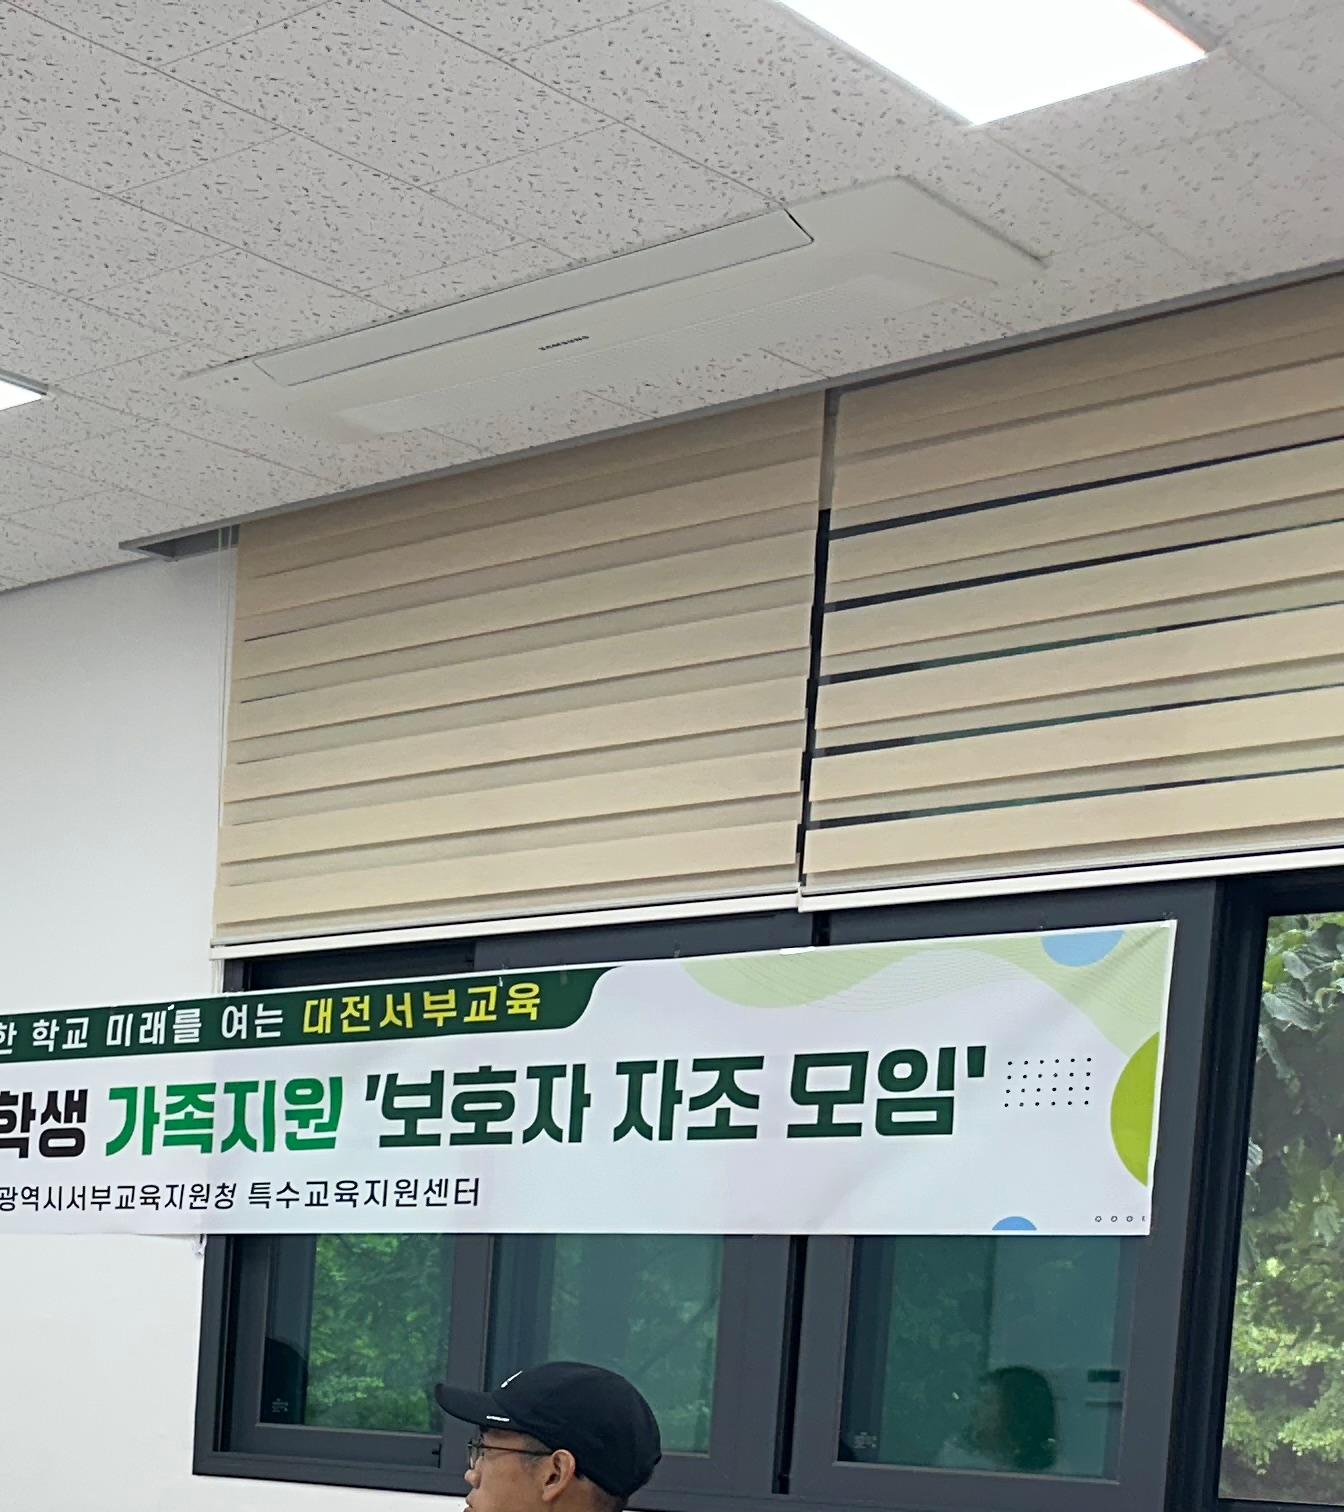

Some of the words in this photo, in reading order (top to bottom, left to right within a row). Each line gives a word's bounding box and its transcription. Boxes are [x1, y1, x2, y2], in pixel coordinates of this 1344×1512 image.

[32, 1016, 90, 1053] 학교
[106, 1008, 202, 1047] 미래를
[221, 1003, 284, 1040] 여는
[303, 982, 540, 1034] 대전서부교육
[106, 1077, 344, 1157] 가족지원
[613, 1055, 765, 1142] 자조
[247, 1177, 480, 1210] 특수교육지원센터
